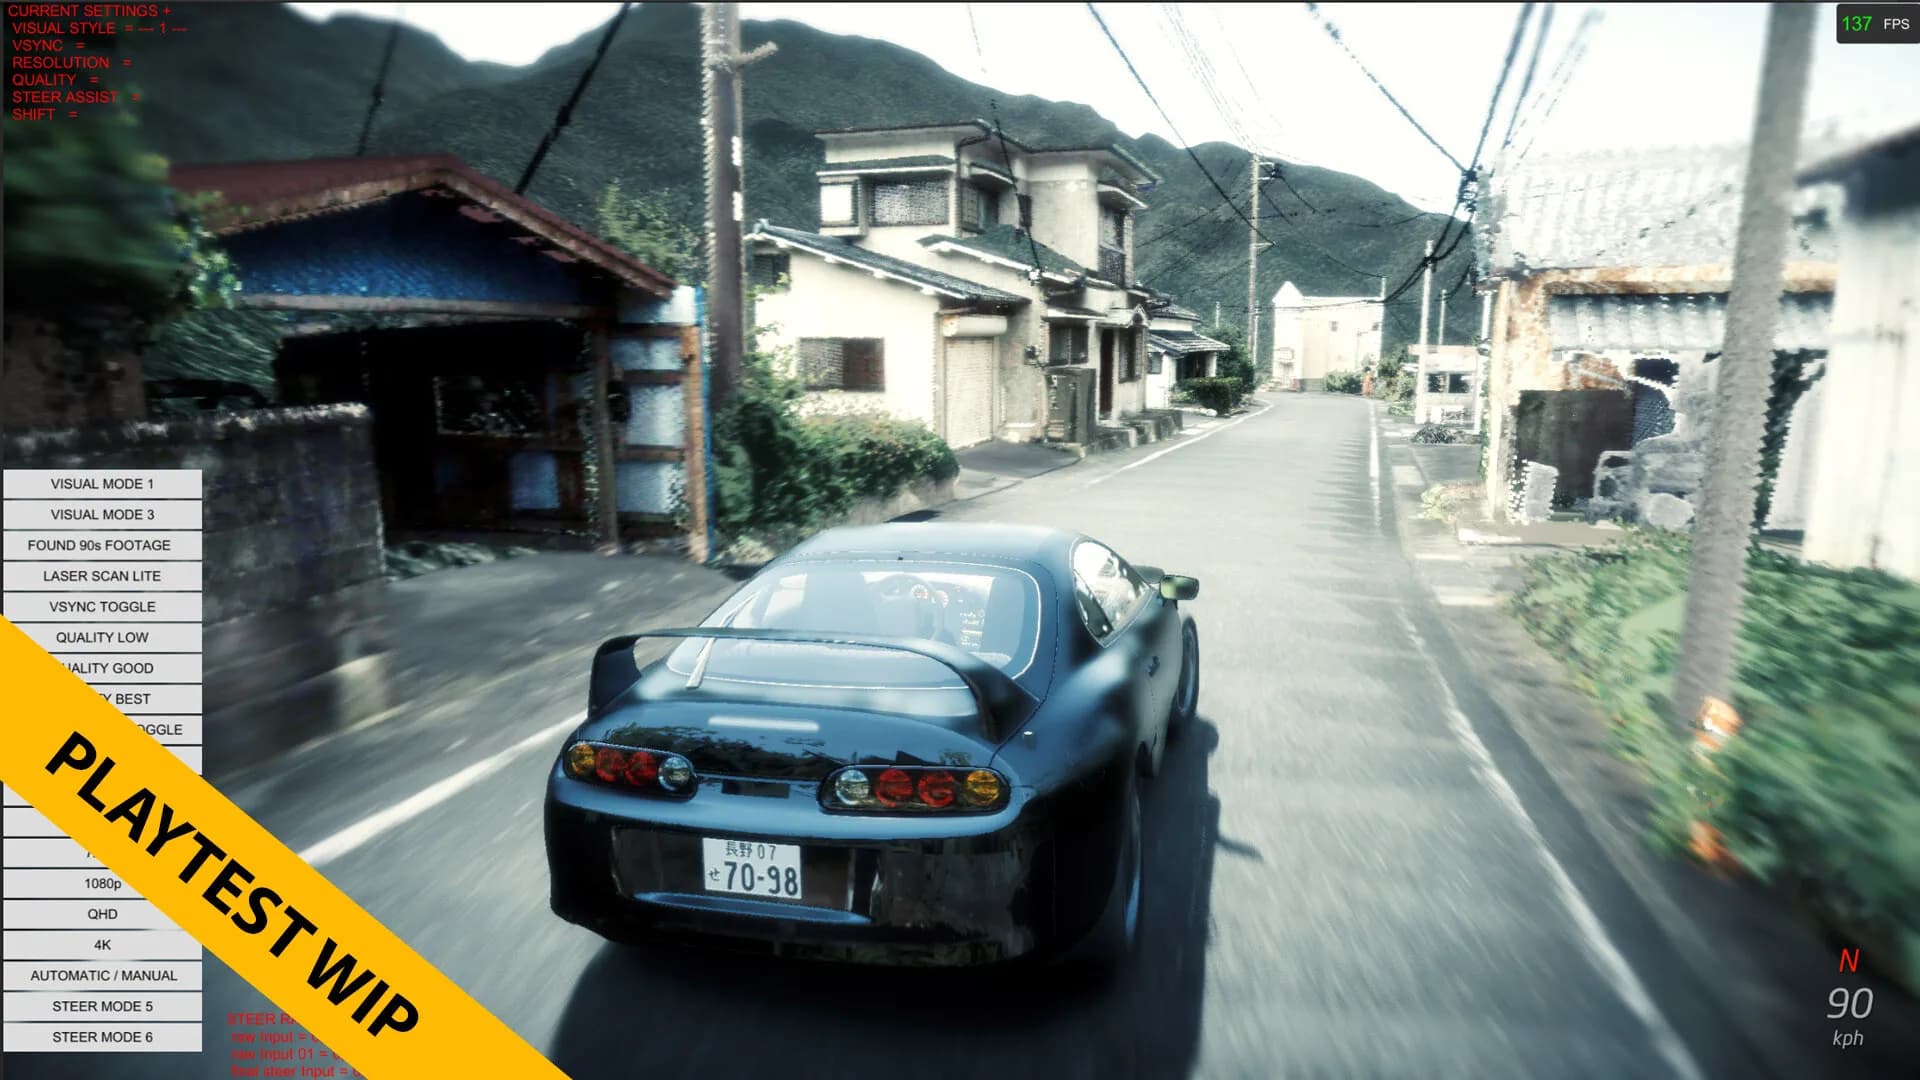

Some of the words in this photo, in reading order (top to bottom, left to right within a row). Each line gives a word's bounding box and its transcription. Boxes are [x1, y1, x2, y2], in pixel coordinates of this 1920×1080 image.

[726, 841, 752, 858] 長野
[757, 845, 776, 860] 07
[724, 861, 798, 896] 70-98
